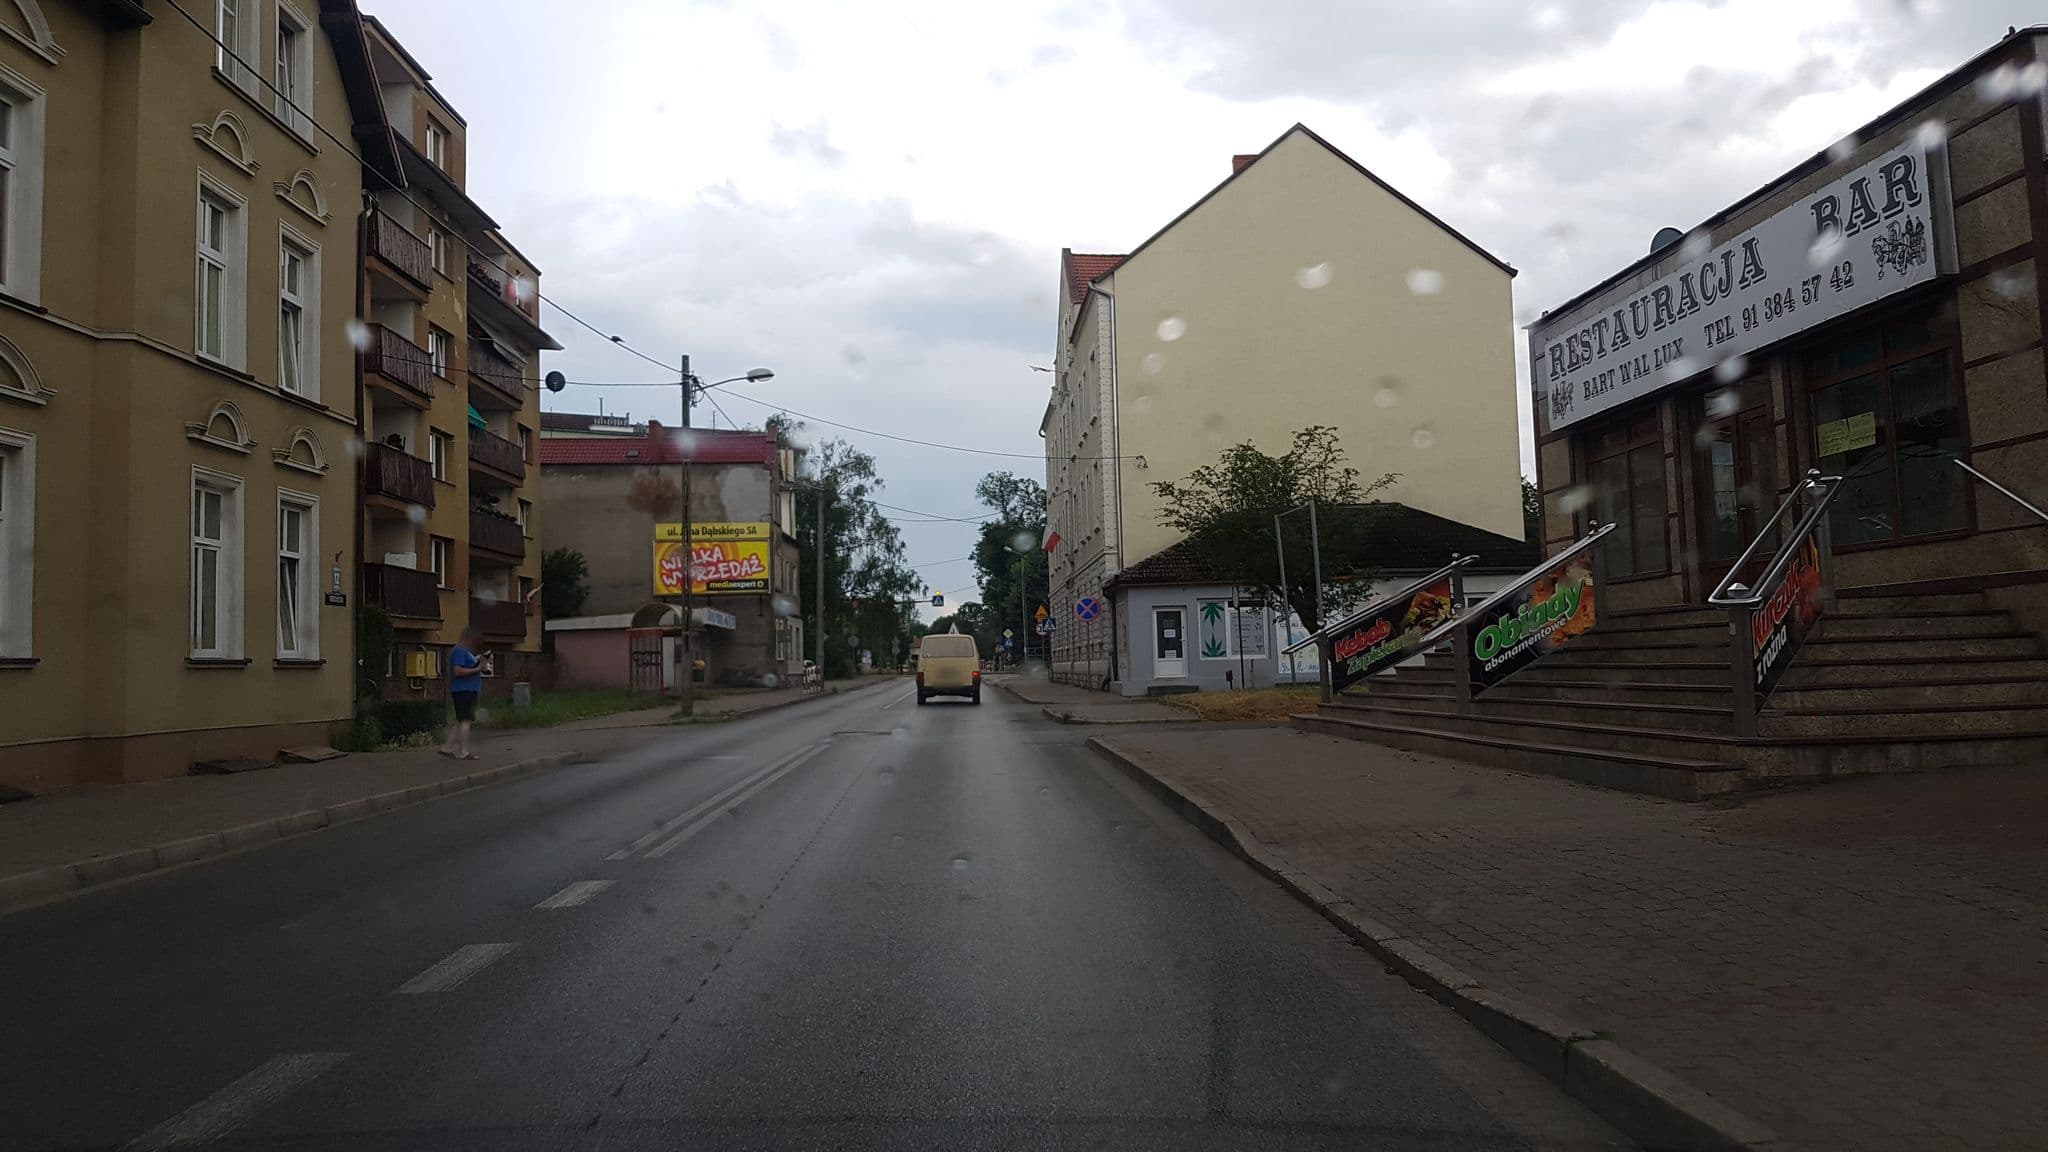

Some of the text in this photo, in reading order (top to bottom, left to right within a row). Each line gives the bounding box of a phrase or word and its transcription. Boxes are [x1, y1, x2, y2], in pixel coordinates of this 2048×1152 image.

[1549, 154, 1923, 381] RESTAURACJA BAR
[1582, 367, 1616, 401] BART
[1620, 354, 1650, 386] WAL
[1653, 337, 1685, 371] LUX
[1742, 305, 1760, 332] 91
[1764, 288, 1797, 324] 384
[1801, 274, 1821, 304] 57
[1829, 261, 1855, 293] 42
[667, 525, 757, 538] ul. Jna Dąbskiego 5A
[662, 545, 724, 570] WILKA
[662, 555, 764, 587] WRZEDAŻ
[709, 580, 756, 590] mediaexpert
[1474, 576, 1585, 661] Obiady
[1334, 617, 1392, 662] Kebab
[1484, 618, 1567, 672] abonamentowe
[1756, 663, 1763, 685] z
